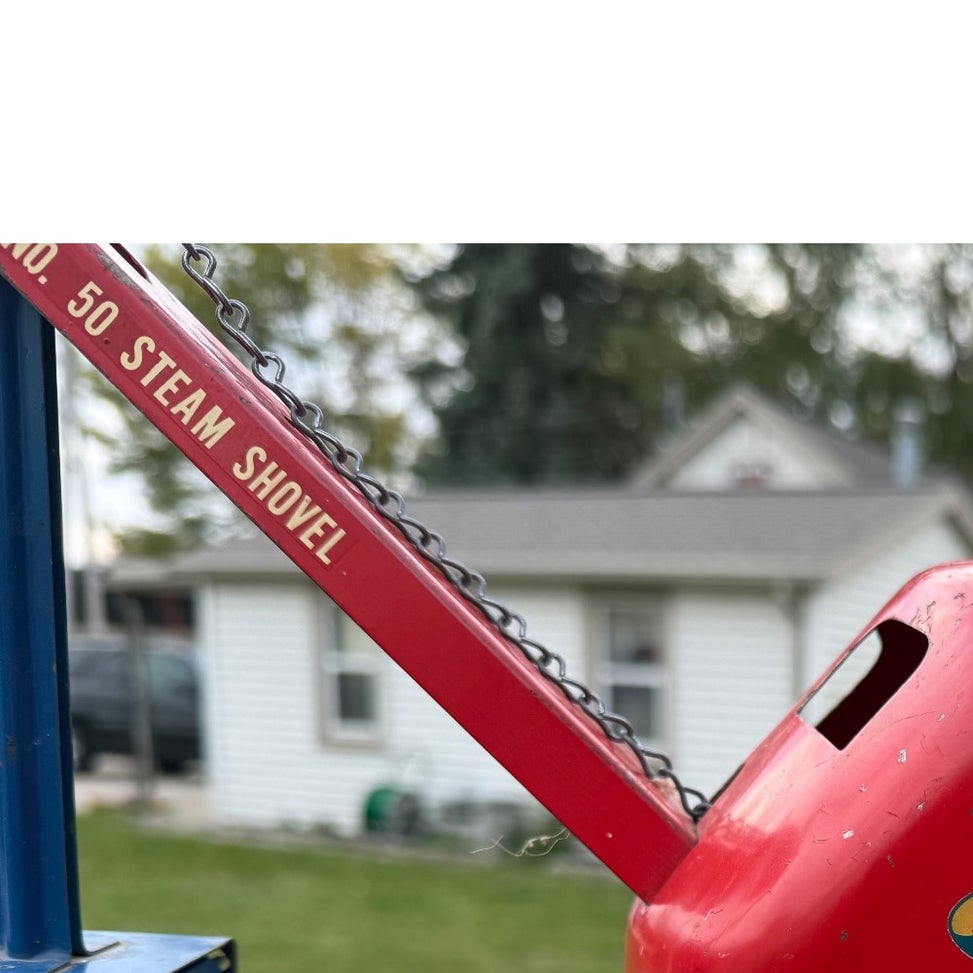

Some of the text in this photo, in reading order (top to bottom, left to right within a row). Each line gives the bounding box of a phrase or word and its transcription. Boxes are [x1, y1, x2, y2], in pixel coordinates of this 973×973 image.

[67, 281, 119, 336] 50
[120, 336, 236, 450] STEAM
[233, 446, 347, 565] SHOVEL
